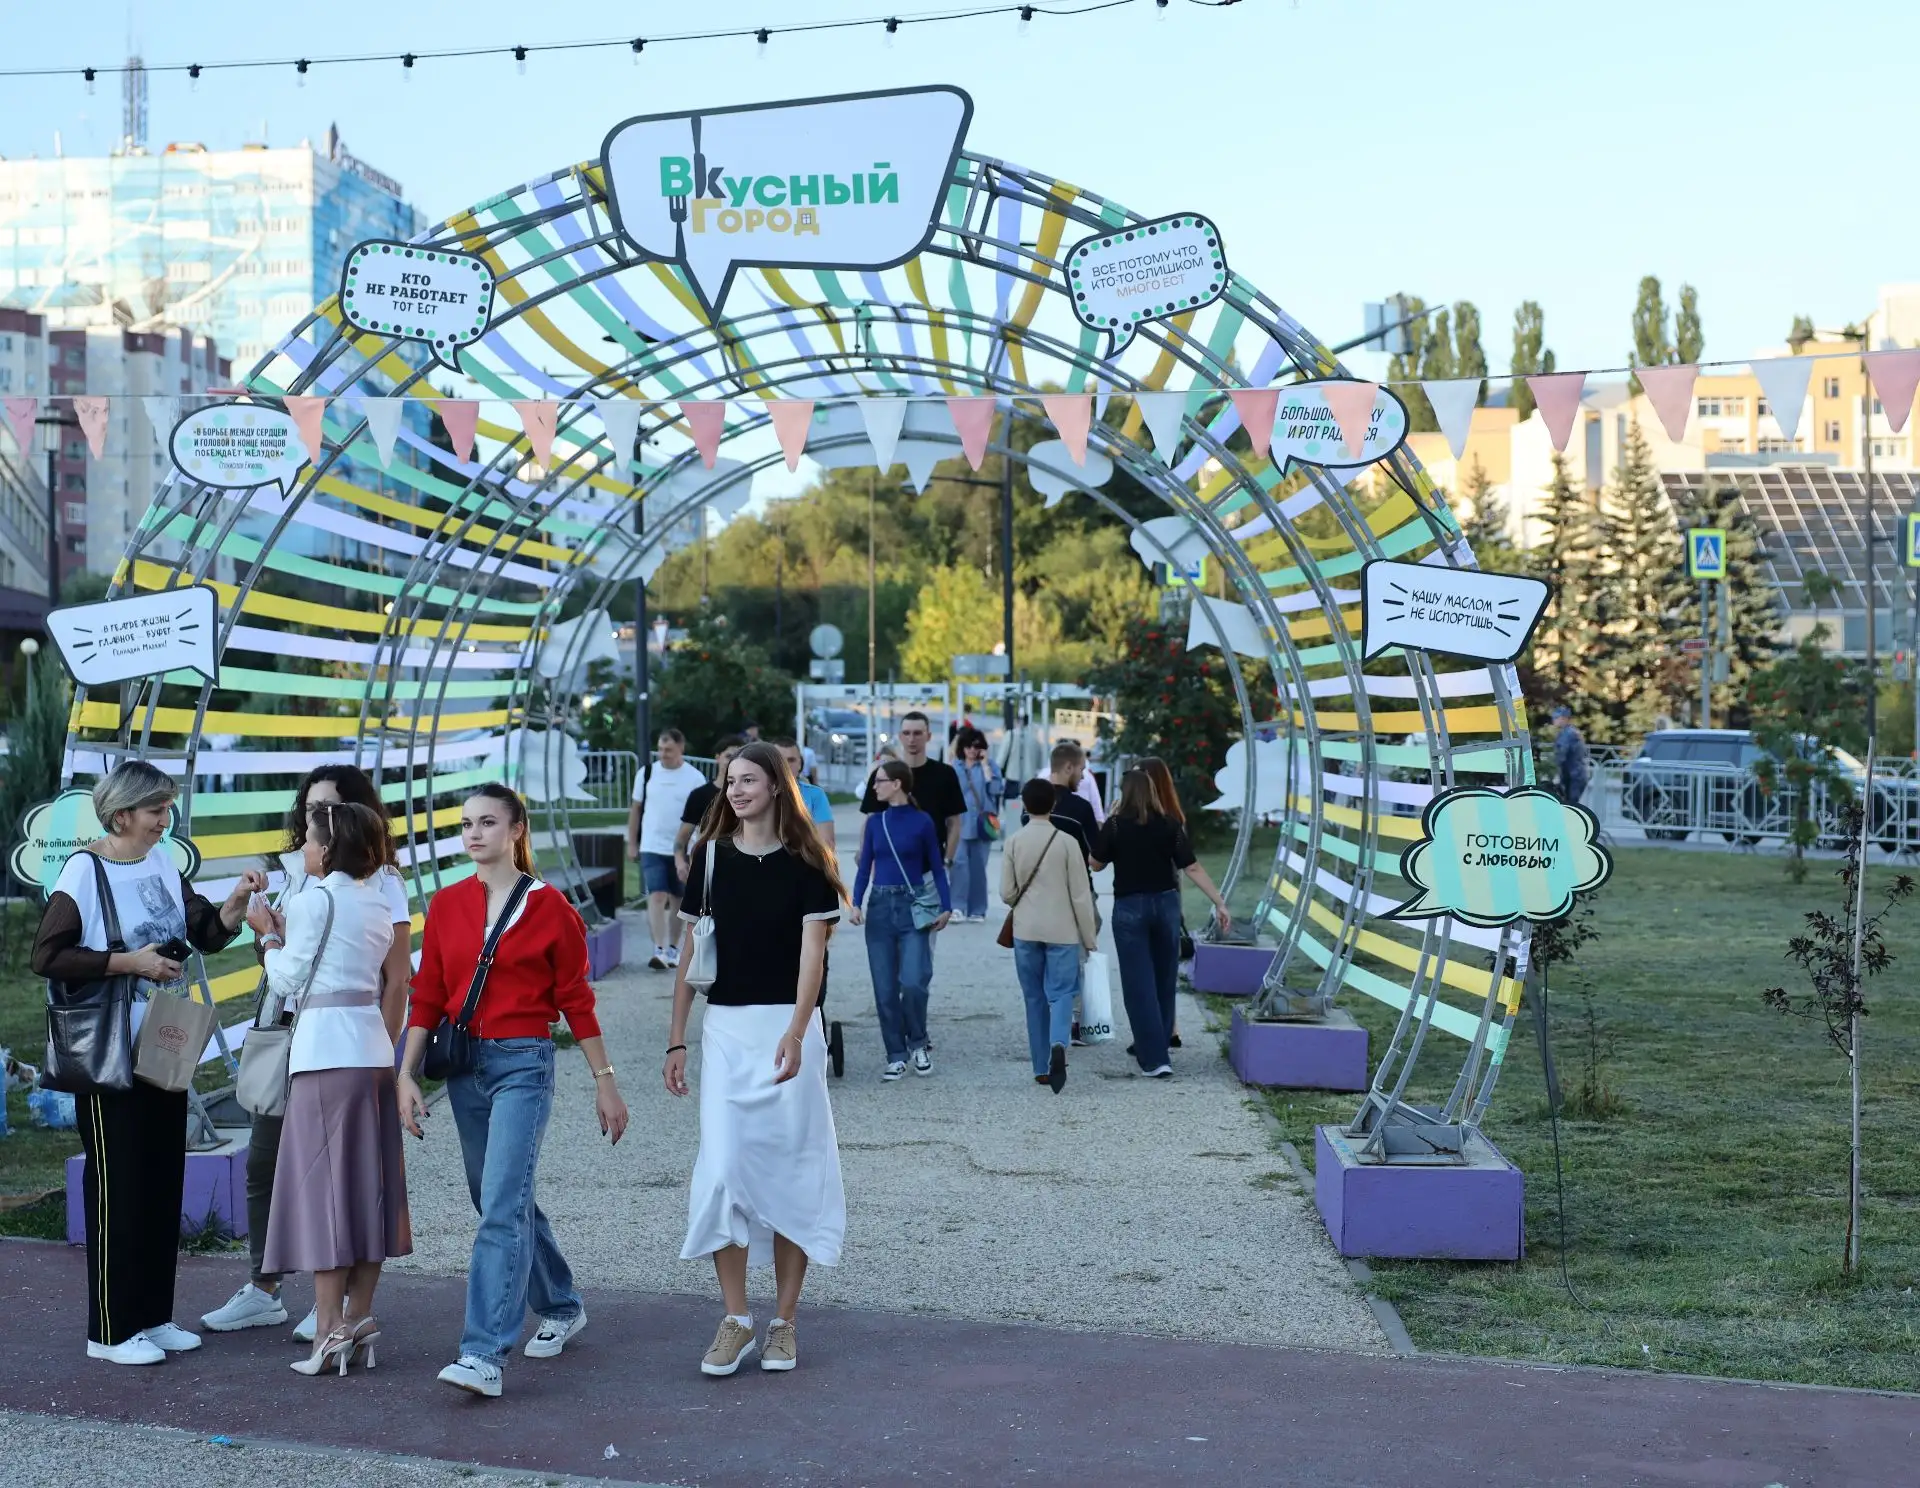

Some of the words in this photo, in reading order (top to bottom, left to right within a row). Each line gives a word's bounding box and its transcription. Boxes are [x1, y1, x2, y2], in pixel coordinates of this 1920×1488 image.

[1092, 262, 1116, 278] ВСЕ
[1119, 250, 1171, 272] ПОТОМУ
[1173, 245, 1198, 259] ЧТО
[401, 273, 431, 286] КТО
[1091, 272, 1133, 291] КТО-ТО
[1136, 257, 1204, 281] СЛИШКОМ
[366, 283, 386, 295] НЕ
[390, 286, 467, 304] РАБОТАЕТ
[1116, 280, 1160, 298] МНОГО
[1163, 274, 1186, 289] ЕСТ
[393, 300, 413, 312] ТОТ
[418, 302, 438, 315] ЕСТ
[202, 427, 228, 437] БОРЬБЕ
[229, 428, 254, 438] МЕЖДУ
[256, 428, 288, 438] СЕРДЦЕМ
[1287, 425, 1296, 439] И
[1299, 425, 1320, 439] РОТ
[194, 439, 199, 448] И
[200, 438, 230, 448] ГОЛОВОЙ
[231, 439, 236, 448] В
[237, 439, 258, 448] КОНЦЕ
[260, 439, 286, 449] КОНЦОВ
[195, 449, 241, 458] ПОБЕЖДАЕТ
[1412, 589, 1442, 604] КАШУ
[1444, 595, 1492, 613] МАСЛОМ
[141, 614, 170, 627] ЖИЗНИ
[1410, 606, 1425, 619] НЕ
[1429, 608, 1493, 629] ИСПОРТИШЬ
[98, 633, 135, 647] ГЛАВНОЕ
[1467, 834, 1559, 852] ГОТОВИМ
[1463, 853, 1472, 865] С
[1475, 853, 1556, 870] ЛЮБОВЬЮ!
